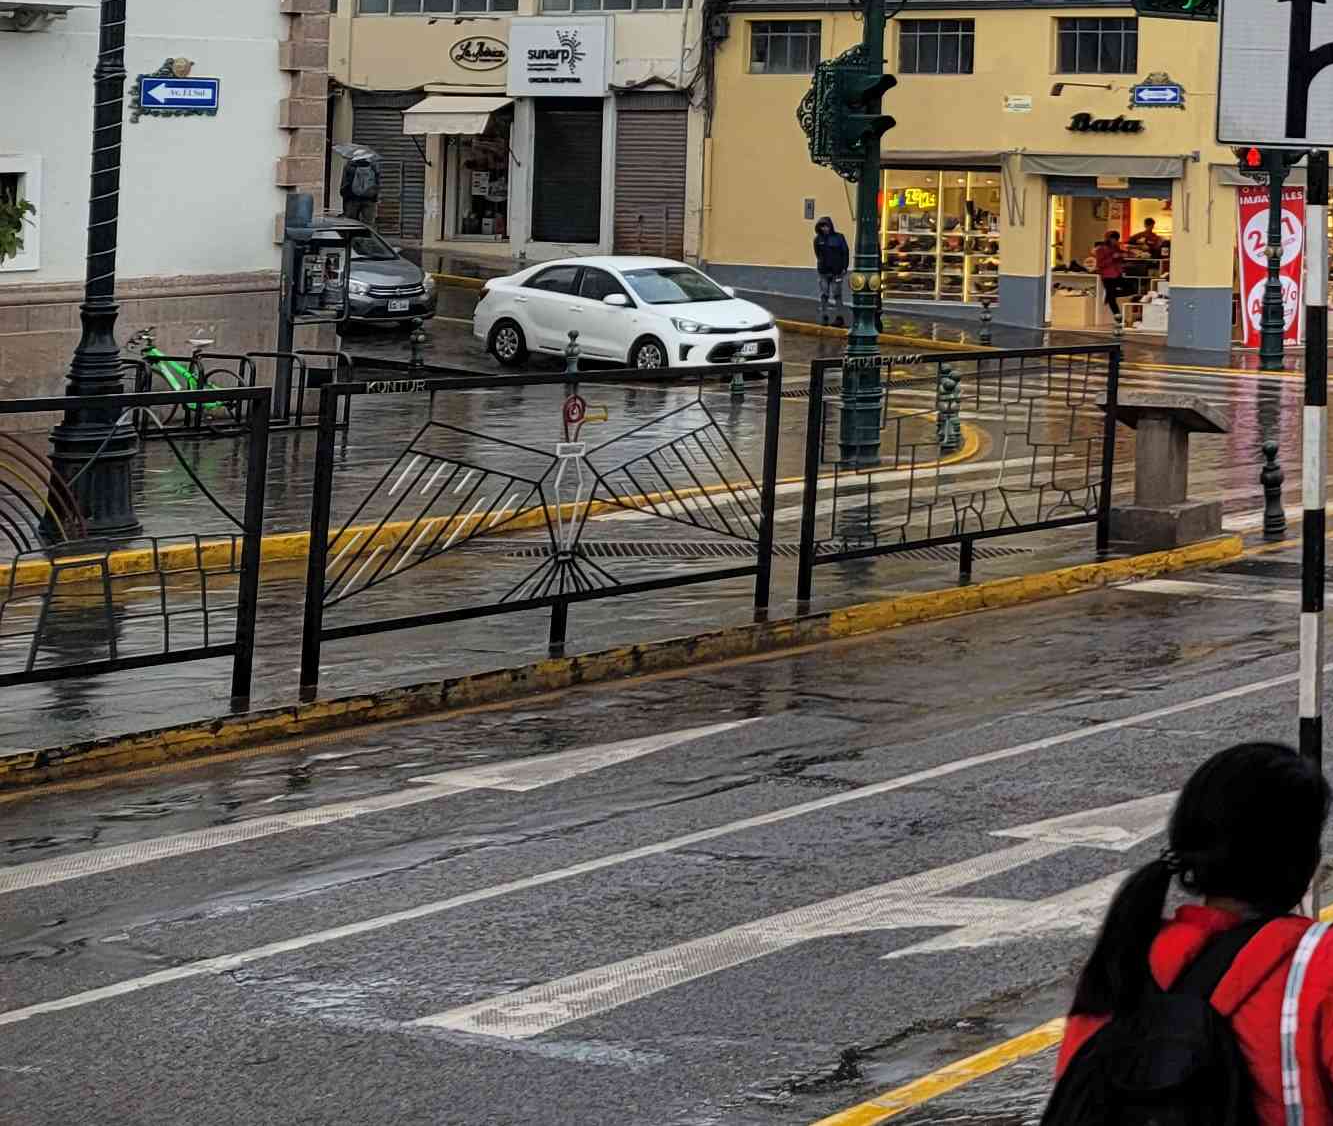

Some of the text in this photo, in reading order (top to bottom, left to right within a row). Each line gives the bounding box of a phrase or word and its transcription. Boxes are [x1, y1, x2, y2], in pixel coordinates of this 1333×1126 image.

[527, 48, 570, 64] sunarp
[1066, 112, 1145, 133] Bata
[367, 380, 426, 394] KUNTUR
